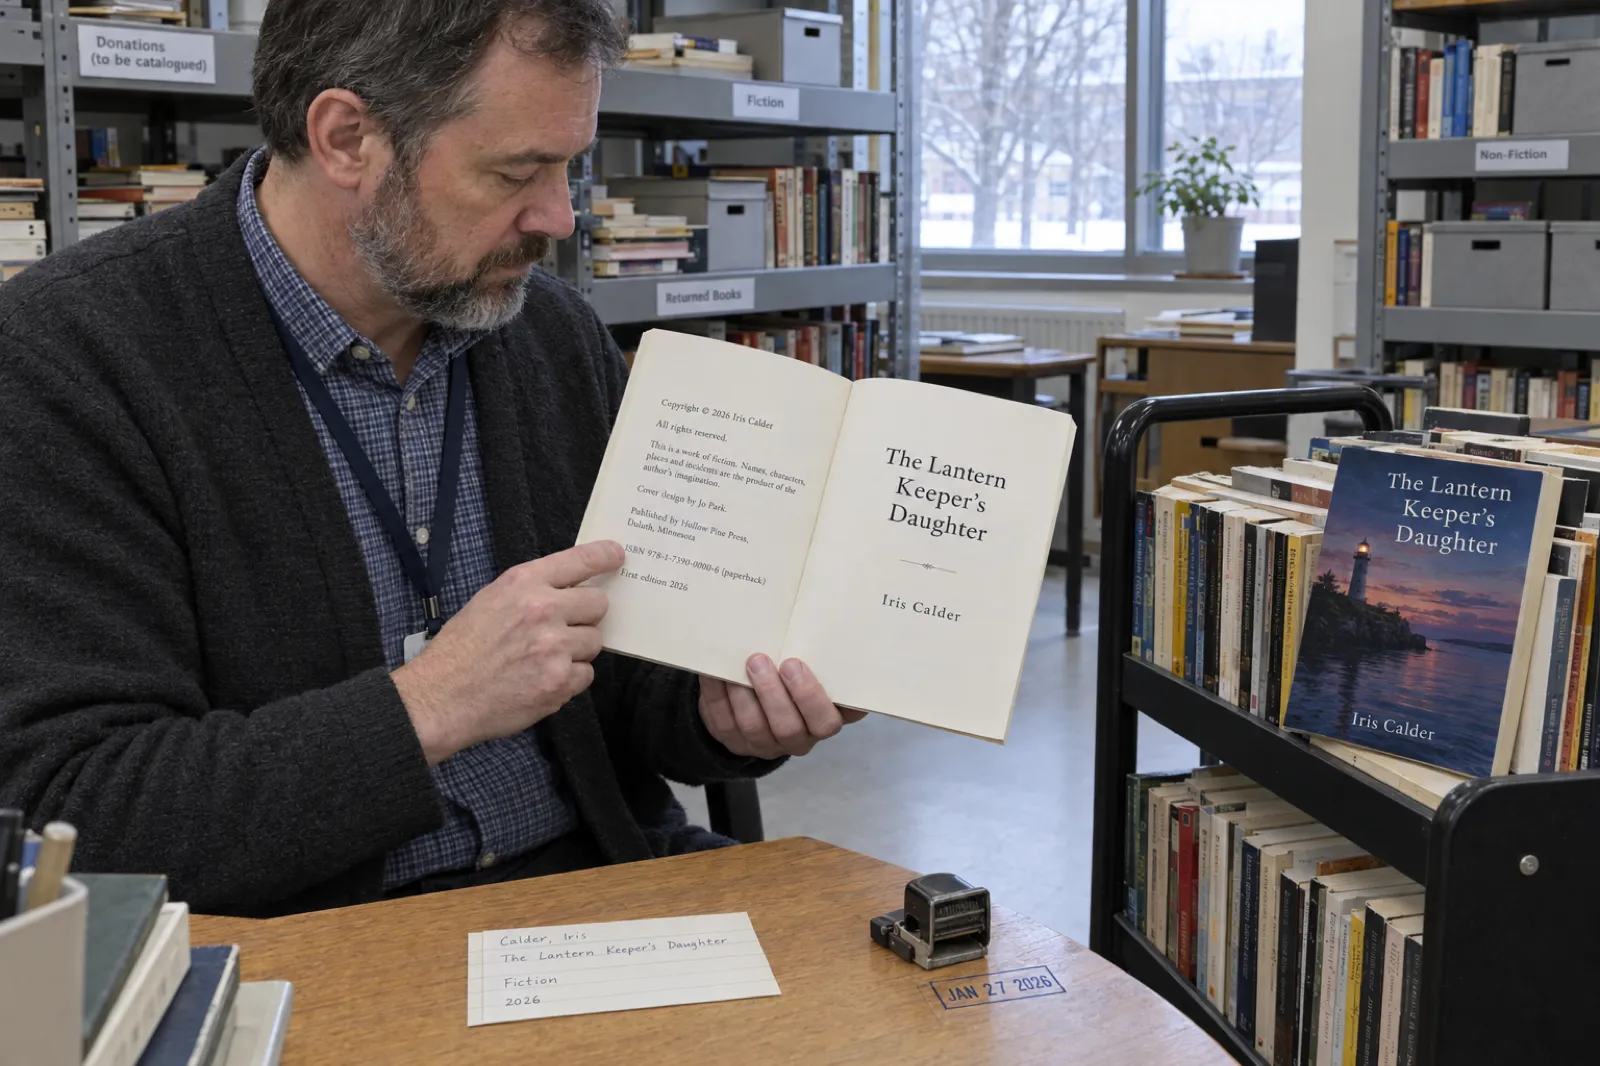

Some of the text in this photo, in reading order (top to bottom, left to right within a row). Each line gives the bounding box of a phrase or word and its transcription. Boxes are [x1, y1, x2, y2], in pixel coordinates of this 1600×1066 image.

[96, 36, 166, 53] Donations
[91, 52, 207, 74] (to be catalogued)
[747, 94, 785, 109] Fiction
[1480, 148, 1548, 161] Non-Fiction
[665, 288, 742, 304] Returned Books
[661, 398, 699, 413] Copyright
[712, 409, 730, 419] 2026
[732, 413, 746, 424] Iris
[748, 416, 774, 430] Calder
[656, 419, 727, 442] All rights reserved.
[646, 451, 797, 495] places and incidents are the product of the
[650, 440, 666, 450] This
[668, 443, 674, 451] is
[681, 447, 701, 459] work
[702, 453, 711, 461] of
[712, 455, 738, 468] fiction.
[741, 461, 768, 476] Names,
[769, 469, 806, 487] characters,
[886, 447, 1007, 490] The Lantern
[674, 470, 720, 488] imagination.
[1388, 472, 1513, 502] The Lantern
[637, 485, 727, 513] Cover design by Jo Park.
[627, 517, 696, 542] Duluth, Minnesota
[669, 514, 679, 526] by
[681, 519, 708, 532] Hollow
[709, 526, 726, 538] Pine
[728, 530, 749, 544] Press,
[888, 503, 988, 542] Daughter
[1395, 525, 1498, 555] Daughter
[625, 543, 645, 555] ISBN
[721, 567, 767, 586] (paperback)
[620, 568, 689, 592] First edition 2026
[881, 594, 962, 622] Iris Calder
[1351, 711, 1436, 742] Iris Calder
[500, 932, 588, 948] Calder, Iris
[501, 936, 728, 963] The Lantern Keeper's Daughter
[504, 975, 557, 989] Fiction
[948, 975, 1052, 1002] JAN 27 2026
[505, 995, 541, 1007] 2026
